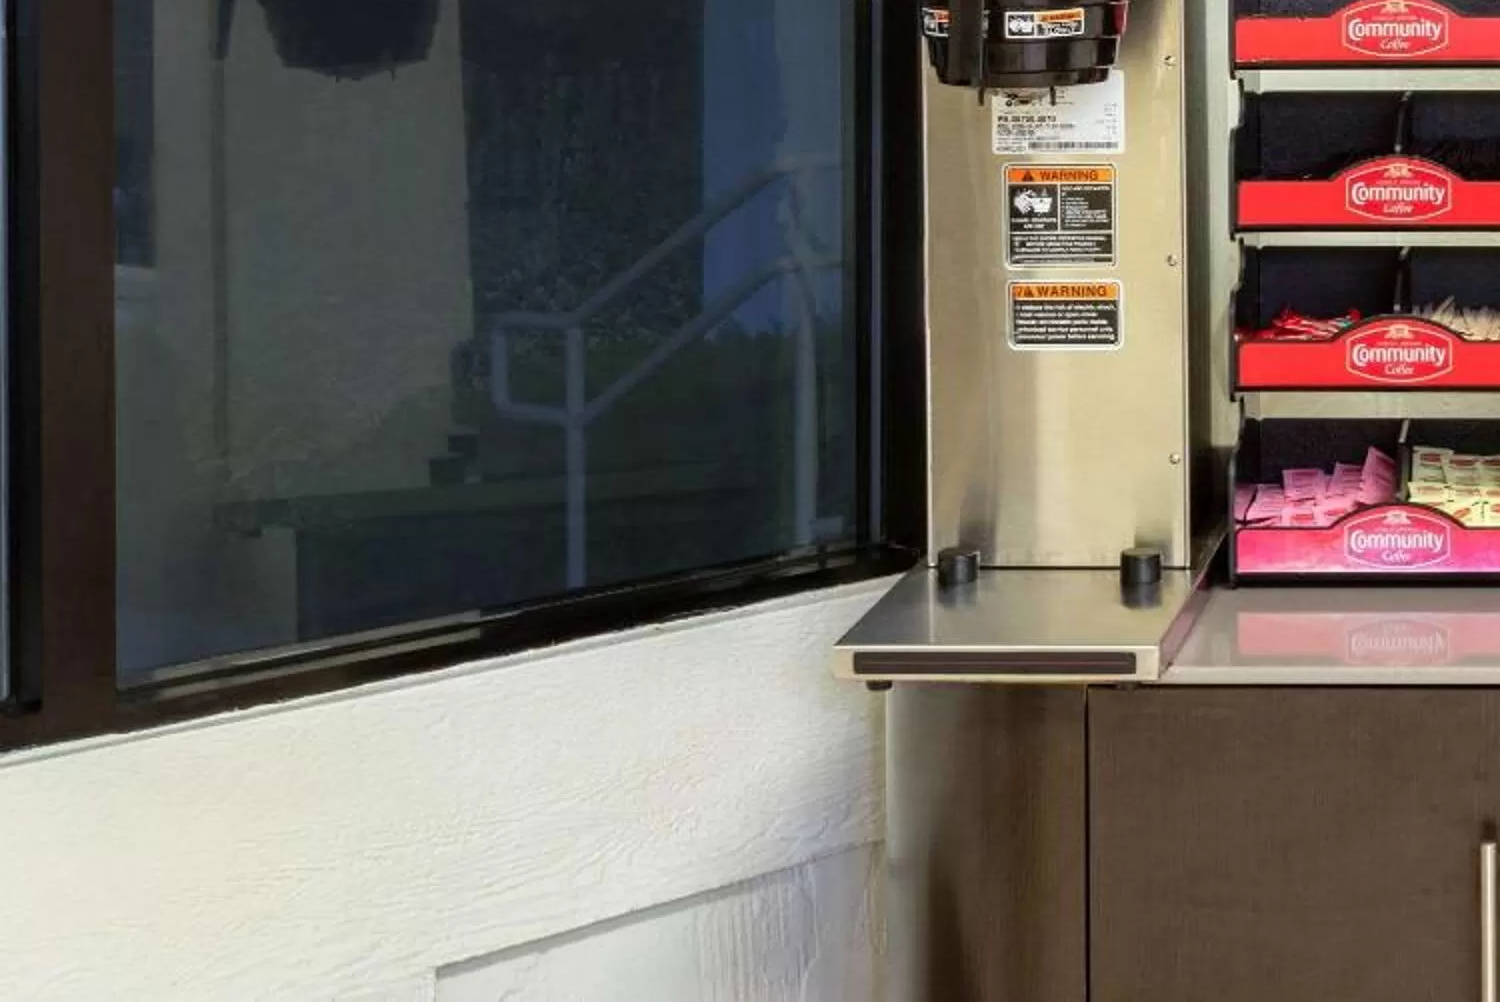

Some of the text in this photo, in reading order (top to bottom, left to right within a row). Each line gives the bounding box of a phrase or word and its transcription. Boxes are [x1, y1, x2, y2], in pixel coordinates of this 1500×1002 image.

[1348, 18, 1442, 41] Community
[1040, 170, 1098, 180] WARNING
[1352, 182, 1445, 205] Community
[1037, 285, 1107, 297] WARNING
[1352, 343, 1446, 367] Community
[1351, 529, 1444, 553] Community
